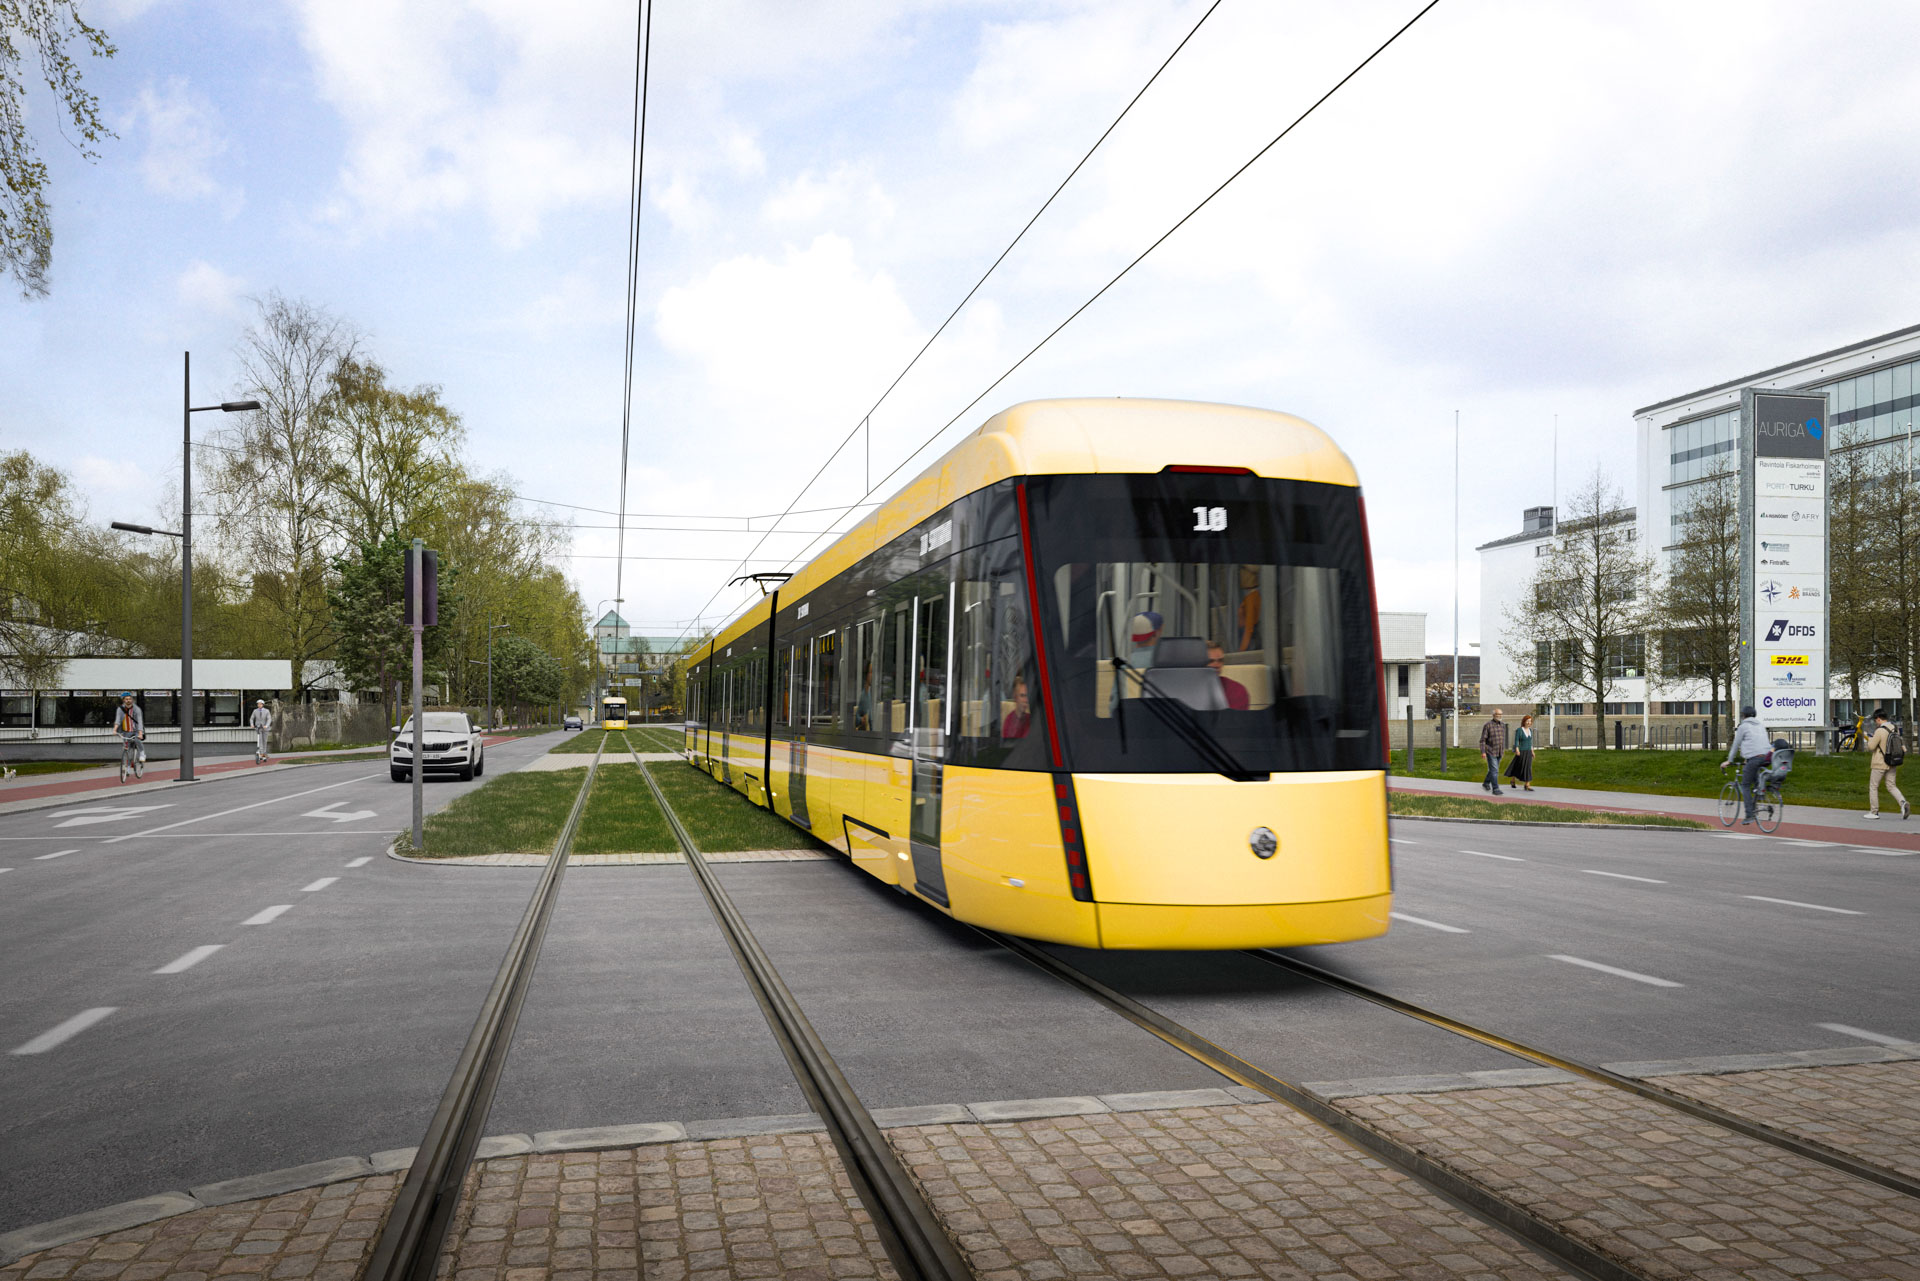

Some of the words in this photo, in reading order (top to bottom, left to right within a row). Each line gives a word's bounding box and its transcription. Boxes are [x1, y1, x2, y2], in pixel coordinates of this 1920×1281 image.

[1759, 421, 1805, 437] AURIGA
[1759, 460, 1784, 469] Ravintola
[1788, 625, 1816, 637] DFDS
[1776, 656, 1803, 664] DHL
[1776, 697, 1816, 709] etteplan
[1807, 712, 1816, 722] 21
